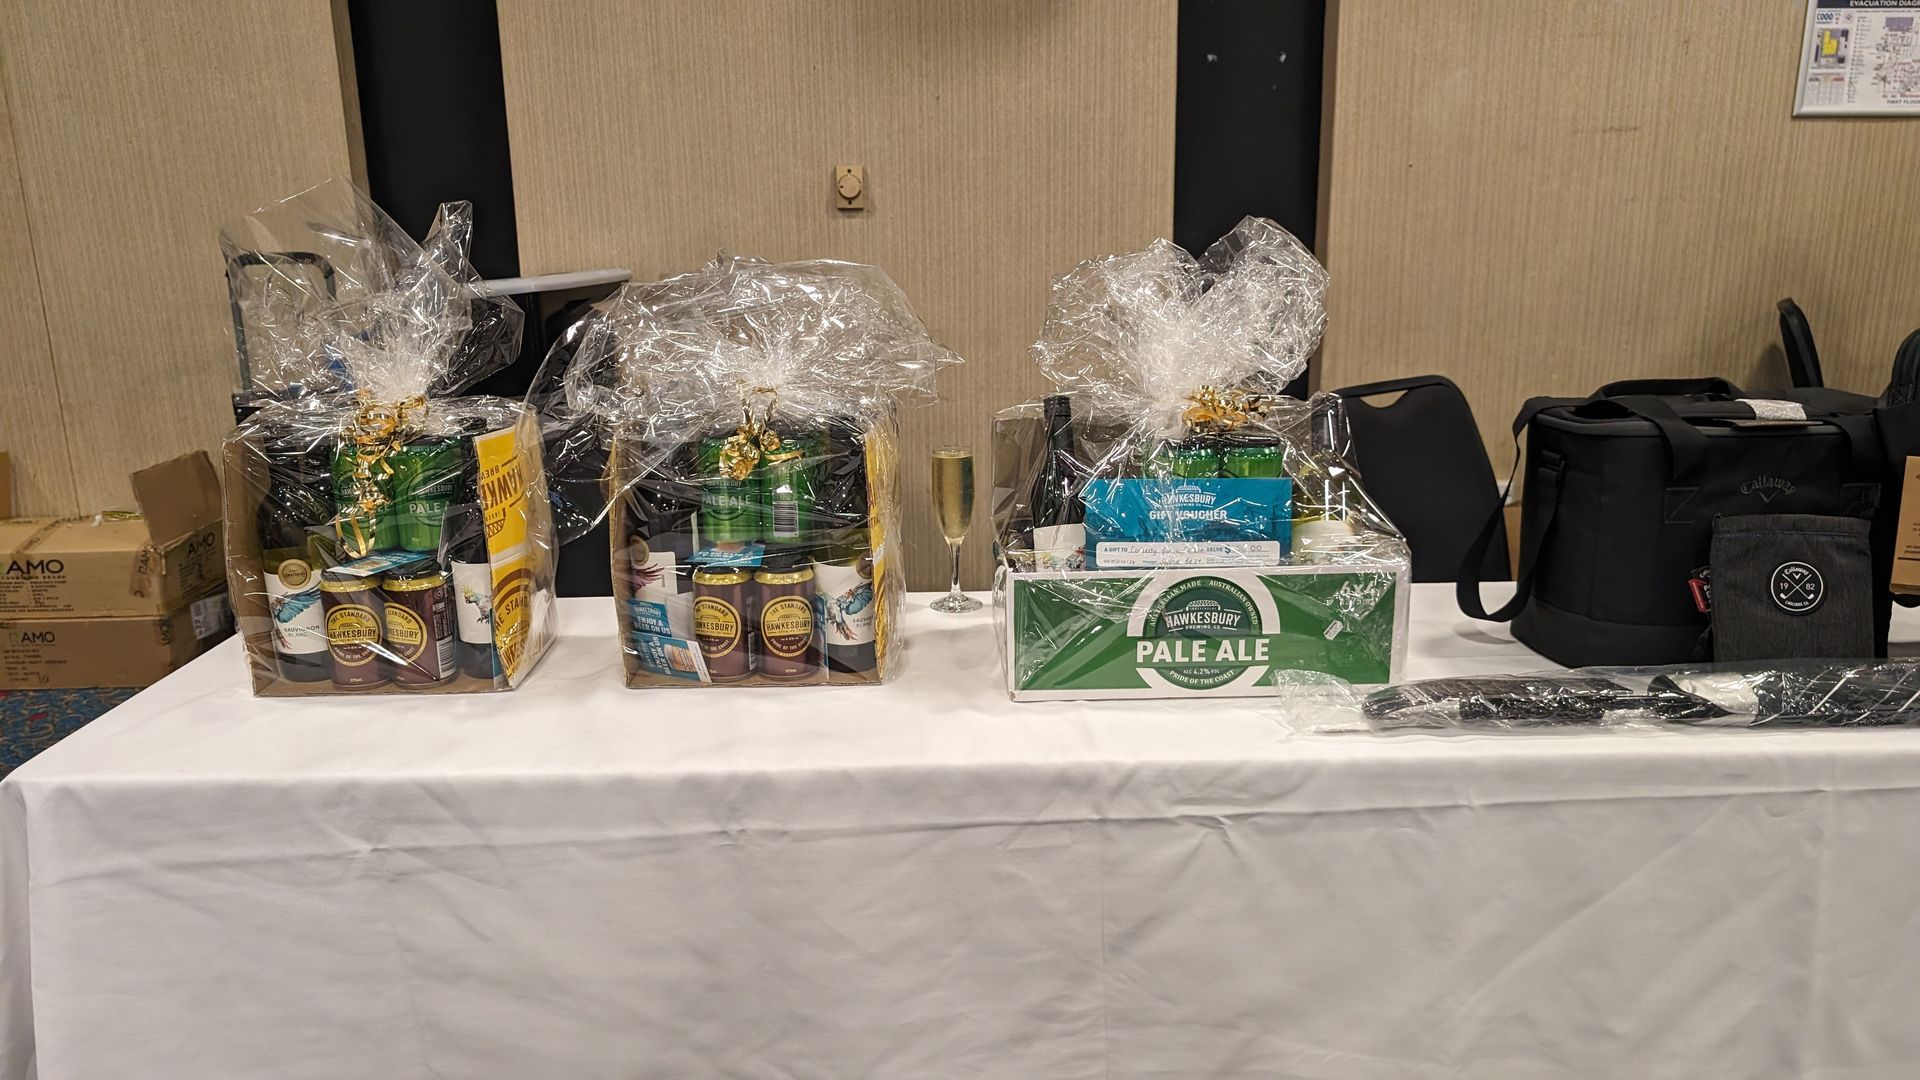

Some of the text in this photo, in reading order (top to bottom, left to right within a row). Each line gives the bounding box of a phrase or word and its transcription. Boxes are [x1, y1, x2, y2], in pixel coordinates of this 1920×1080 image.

[1740, 475, 1796, 496] Callaway
[409, 503, 441, 515] PALE
[1176, 510, 1228, 521] VOUCHER
[1179, 579, 1201, 592] MADE
[1780, 582, 1816, 591] 19 82
[770, 602, 808, 616] THE STANDARD
[1208, 580, 1259, 625] AUSTRALIAN OWNED
[702, 603, 729, 617] STANDARD
[330, 610, 371, 624] THE STANDARD
[637, 616, 664, 627] ENJOY A
[1165, 611, 1241, 629] HAWKESBURY
[661, 627, 671, 635] US
[765, 618, 811, 632] HAWKESBURY
[328, 628, 377, 639] HAWKESBURY
[1136, 639, 1270, 663] PALE ALE
[1169, 670, 1188, 683] PRIDE
[1214, 670, 1236, 683] COAST
